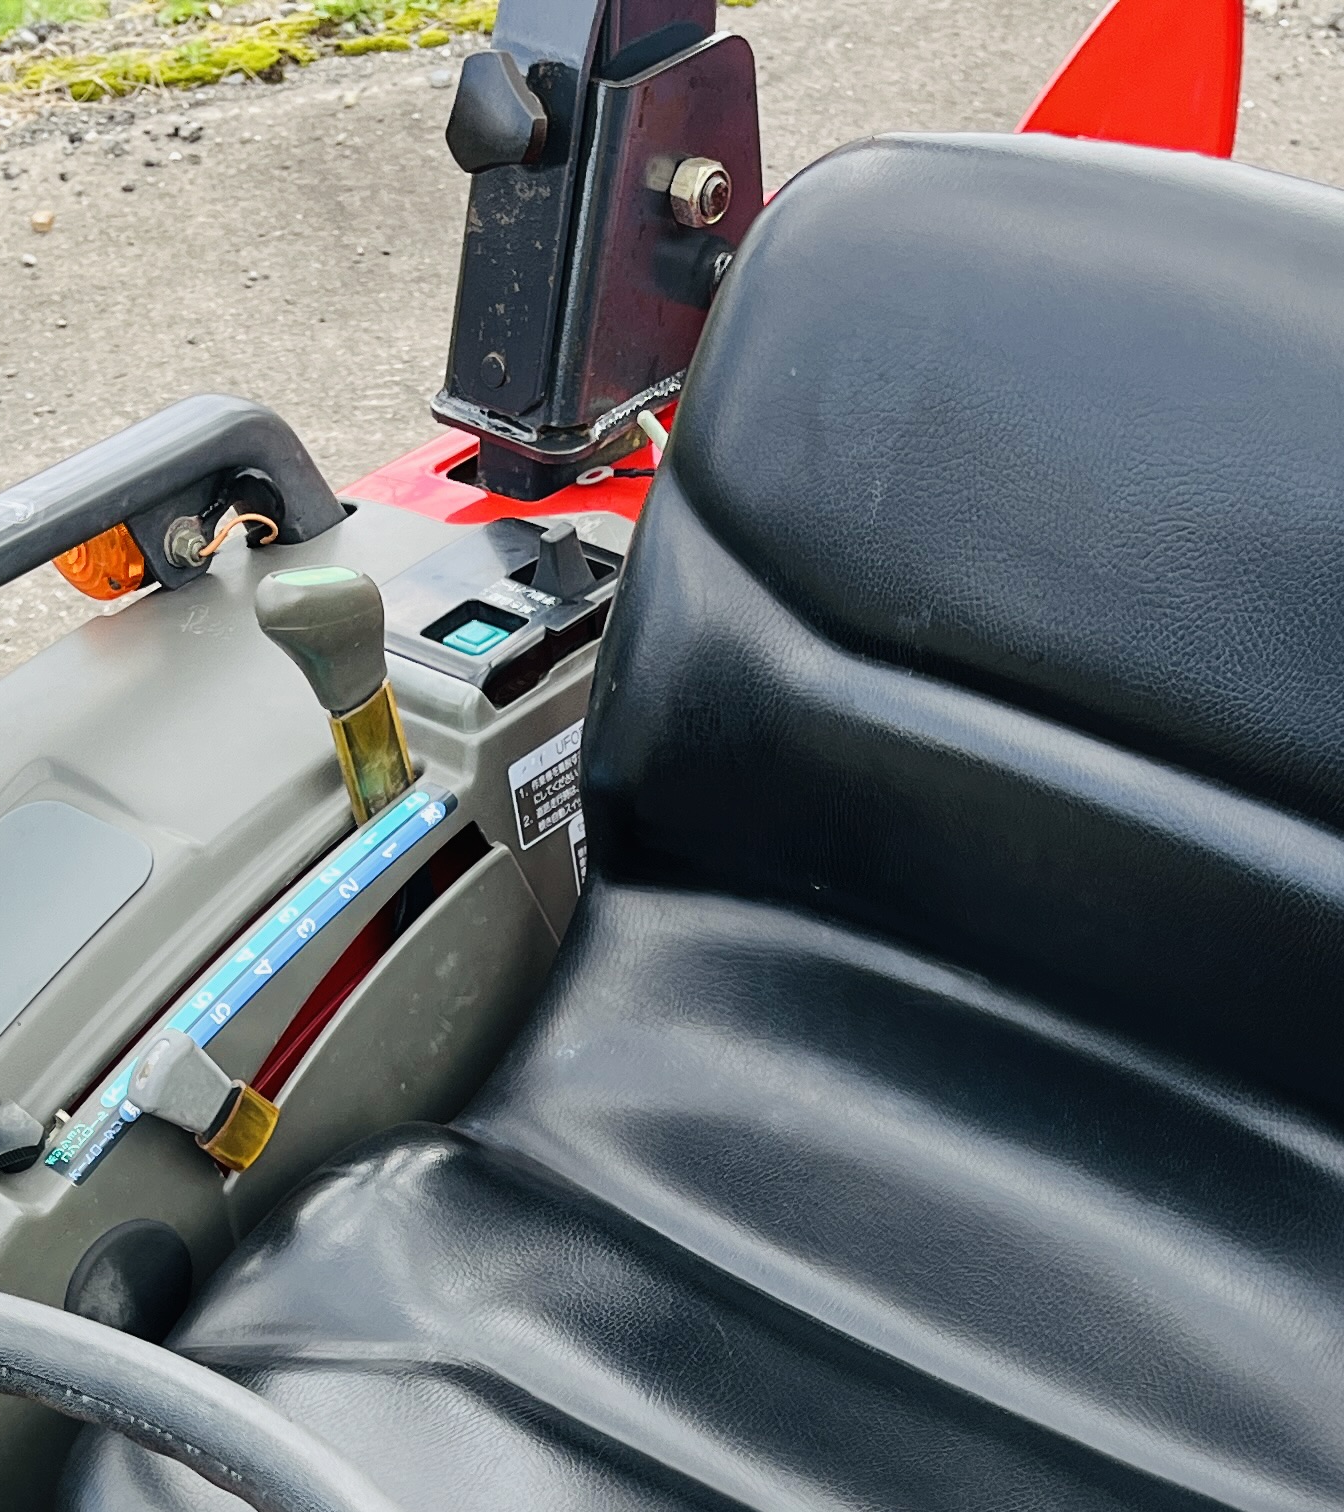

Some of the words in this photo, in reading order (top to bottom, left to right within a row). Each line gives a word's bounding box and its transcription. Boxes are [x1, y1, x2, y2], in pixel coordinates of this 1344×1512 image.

[363, 831, 378, 845] 1
[382, 842, 398, 858] 1
[319, 868, 342, 885] 2
[339, 877, 359, 899] 2
[278, 906, 299, 924] 3
[296, 917, 316, 939] 3
[235, 947, 255, 963] 4
[253, 958, 273, 976] 4
[191, 991, 214, 1010] 5
[210, 1002, 231, 1025] 5
